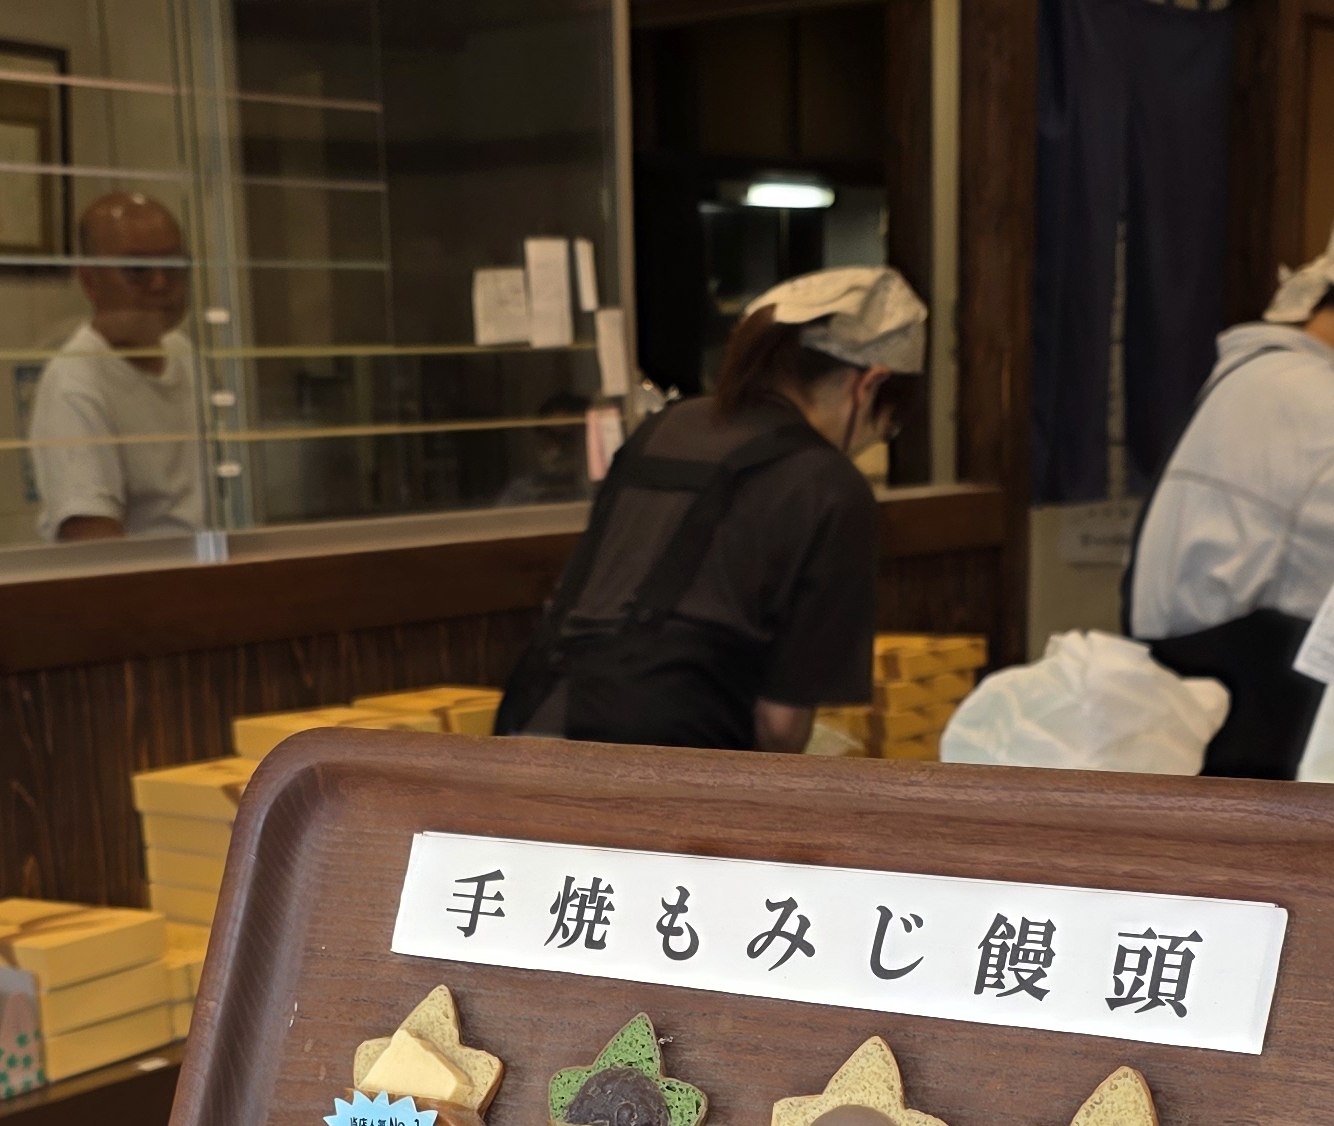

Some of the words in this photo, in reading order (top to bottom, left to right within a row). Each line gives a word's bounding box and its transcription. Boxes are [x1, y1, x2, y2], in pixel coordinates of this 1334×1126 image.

[447, 869, 1204, 1018] 手焼もみじ饅頭
